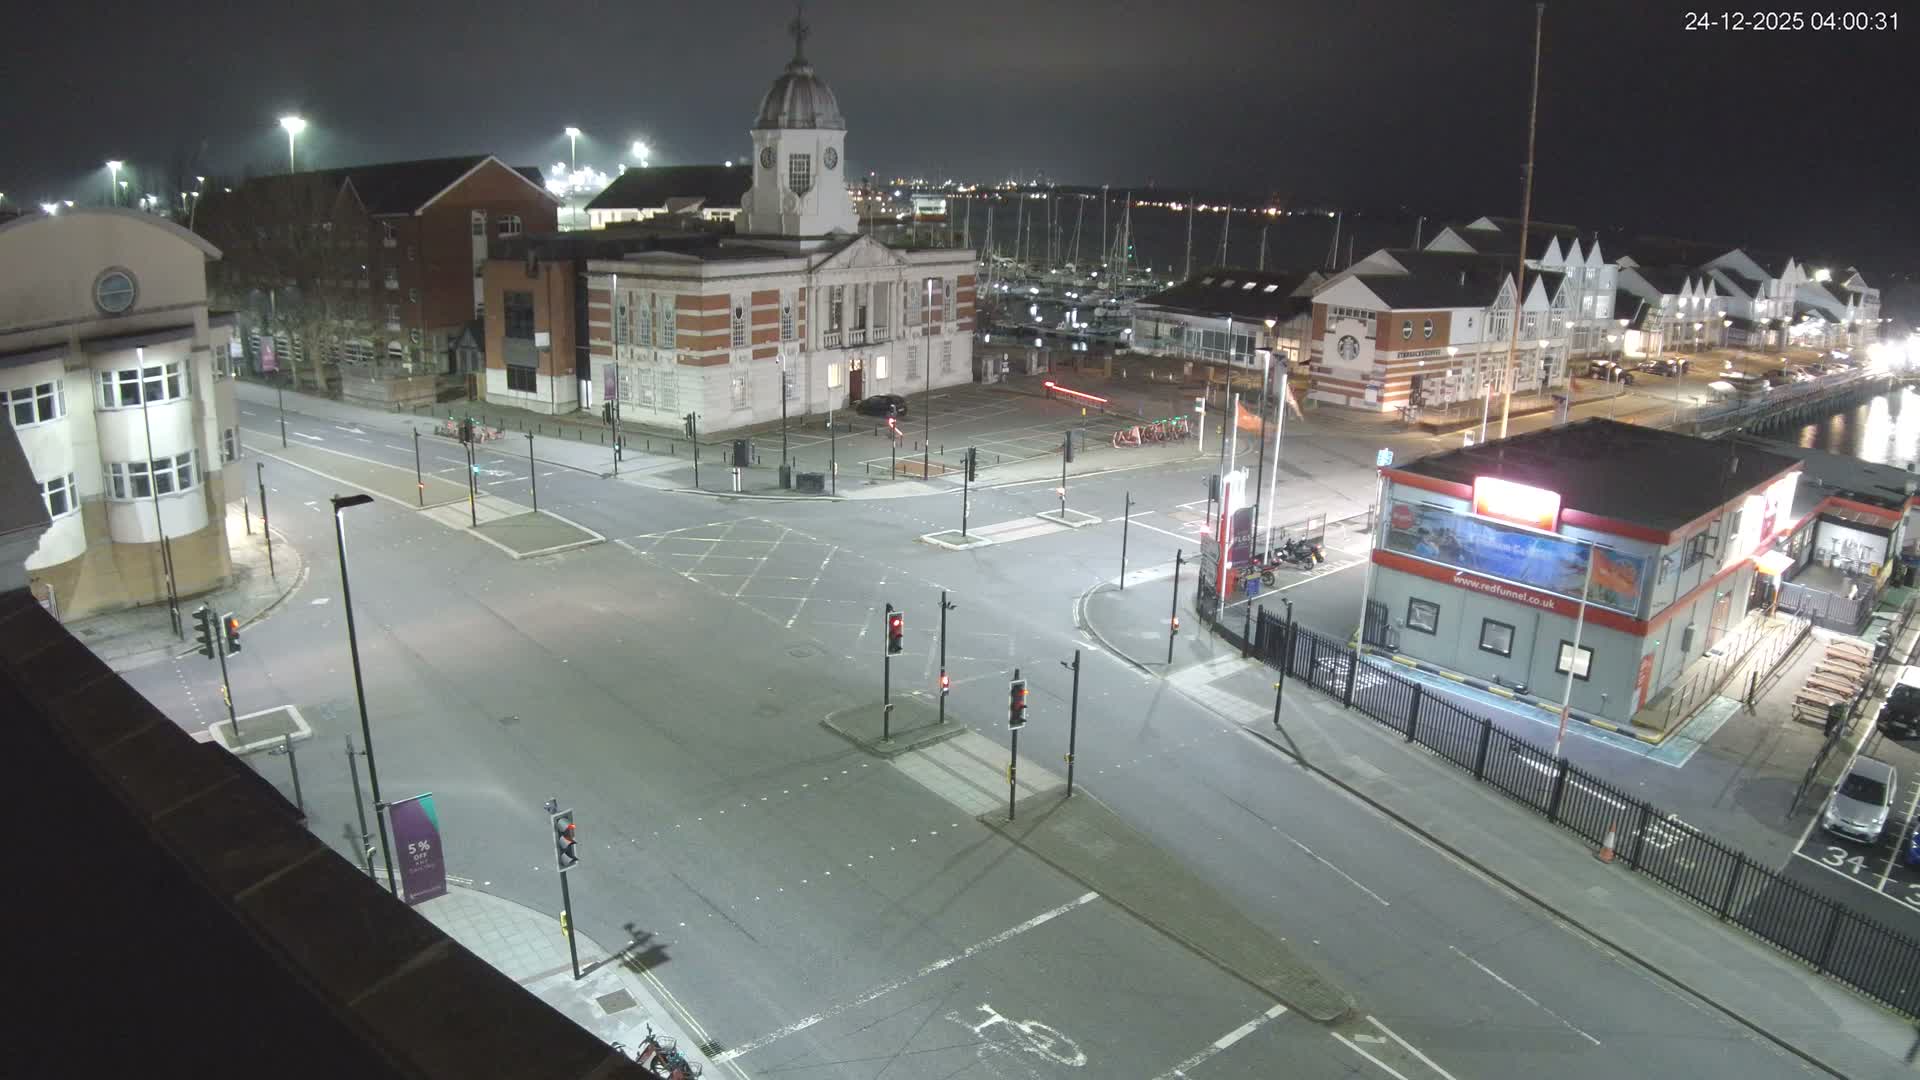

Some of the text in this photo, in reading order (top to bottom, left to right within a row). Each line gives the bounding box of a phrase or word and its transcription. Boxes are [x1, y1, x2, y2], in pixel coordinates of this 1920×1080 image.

[1454, 576, 1555, 608] www.redfunnel.co.uk
[413, 852, 427, 861] OFF
[1821, 846, 1868, 874] 34
